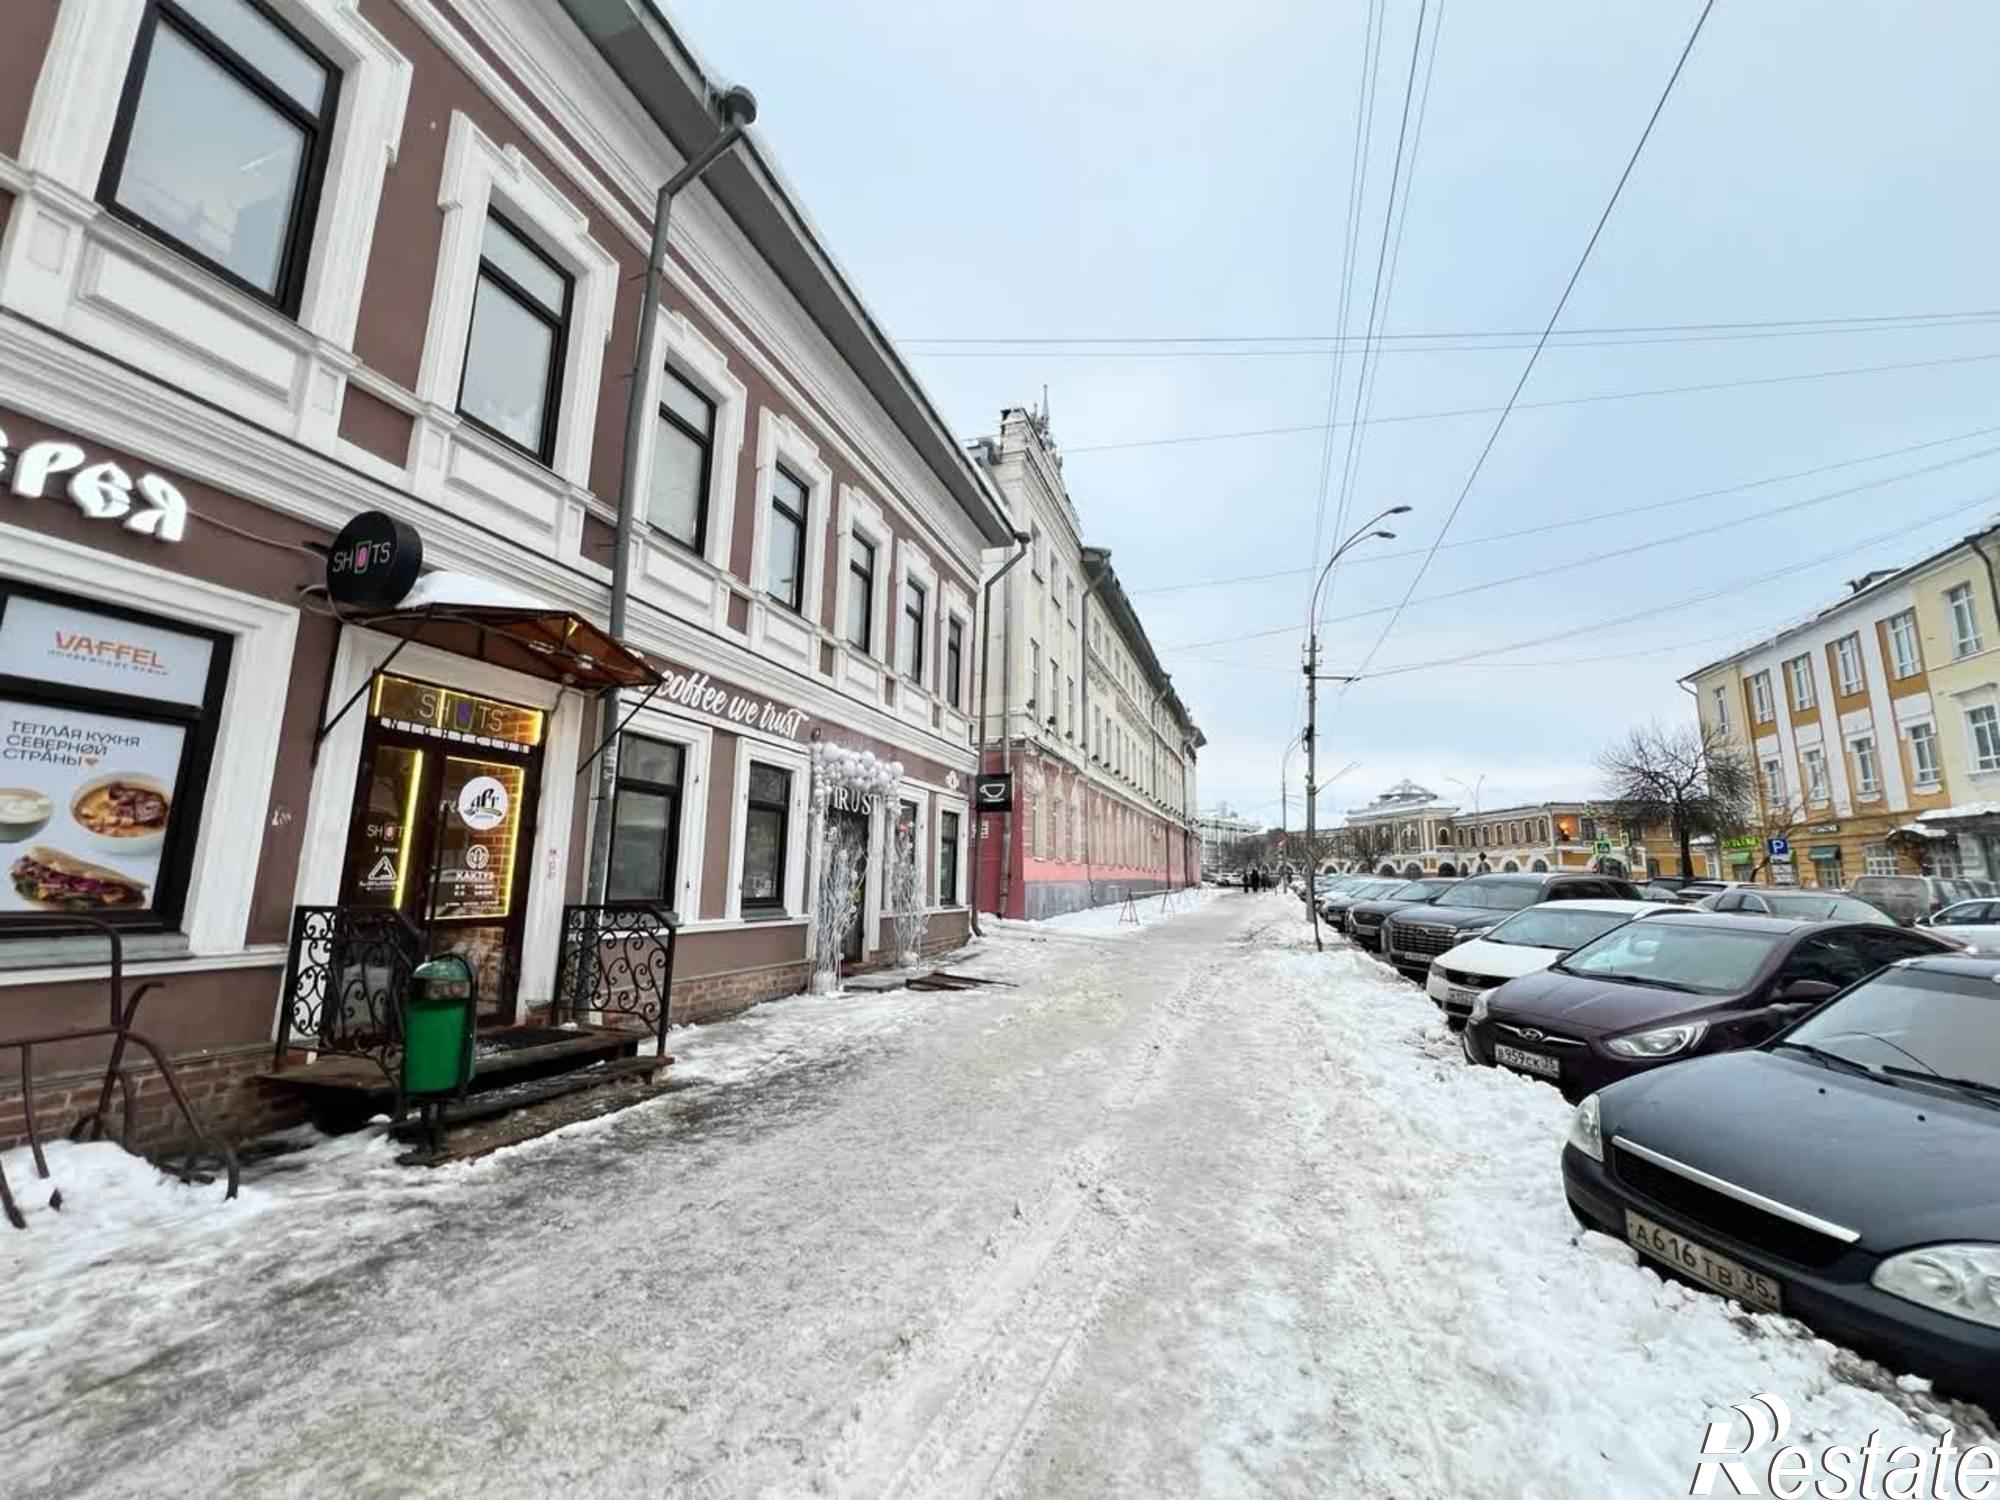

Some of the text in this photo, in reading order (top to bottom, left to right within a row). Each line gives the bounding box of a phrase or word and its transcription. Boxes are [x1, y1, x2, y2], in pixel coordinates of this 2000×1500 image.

[55, 630, 164, 668] VAFFEL
[728, 695, 758, 722] we
[760, 701, 809, 740] trust
[1742, 1269, 1769, 1298] 35
